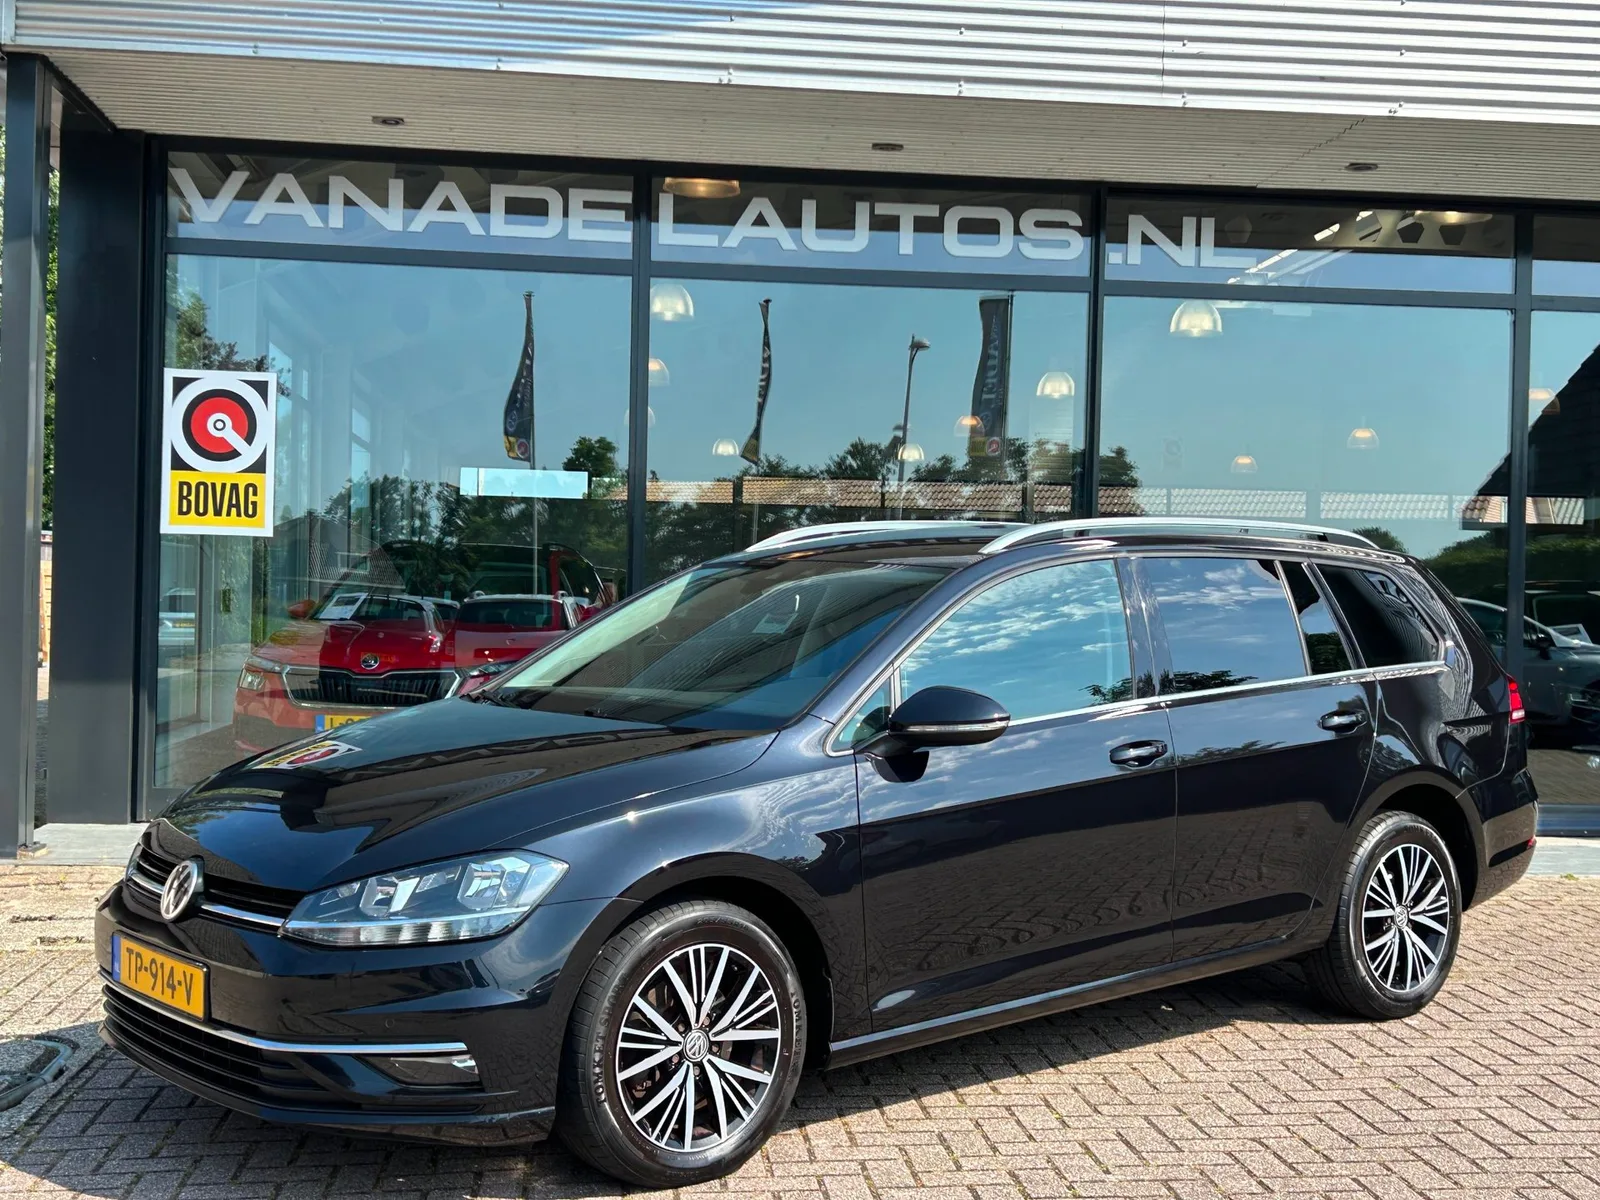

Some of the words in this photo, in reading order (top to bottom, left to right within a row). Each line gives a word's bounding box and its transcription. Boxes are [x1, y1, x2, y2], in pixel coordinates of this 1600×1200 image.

[177, 480, 258, 519] BOVAG
[125, 946, 194, 1006] TP-914-V
[592, 1032, 607, 1107] TOMKET
